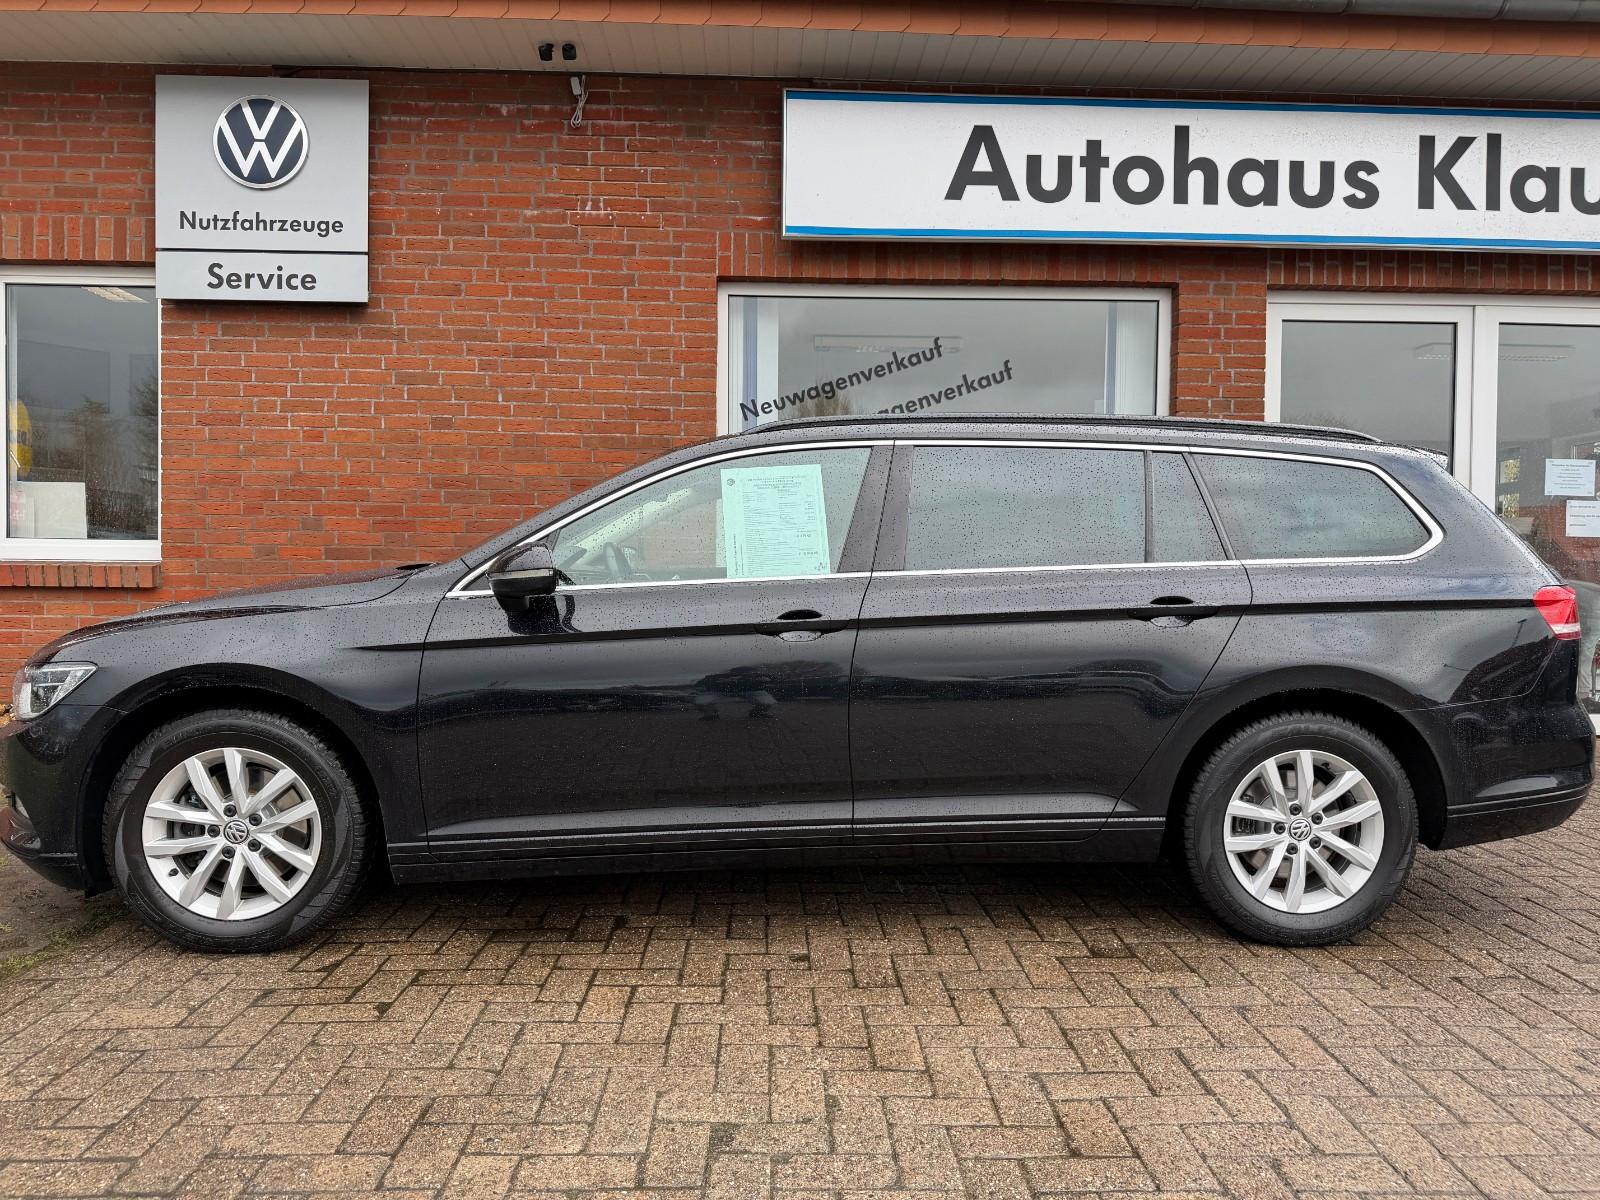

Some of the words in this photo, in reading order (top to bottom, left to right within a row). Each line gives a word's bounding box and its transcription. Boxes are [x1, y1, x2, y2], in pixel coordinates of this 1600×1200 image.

[943, 124, 1380, 210] Autohaus
[1416, 132, 1600, 216] Klau
[179, 210, 344, 238] Nutzfahrzeuge
[206, 262, 317, 291] Service
[739, 337, 943, 422] Neuwagenverkauf
